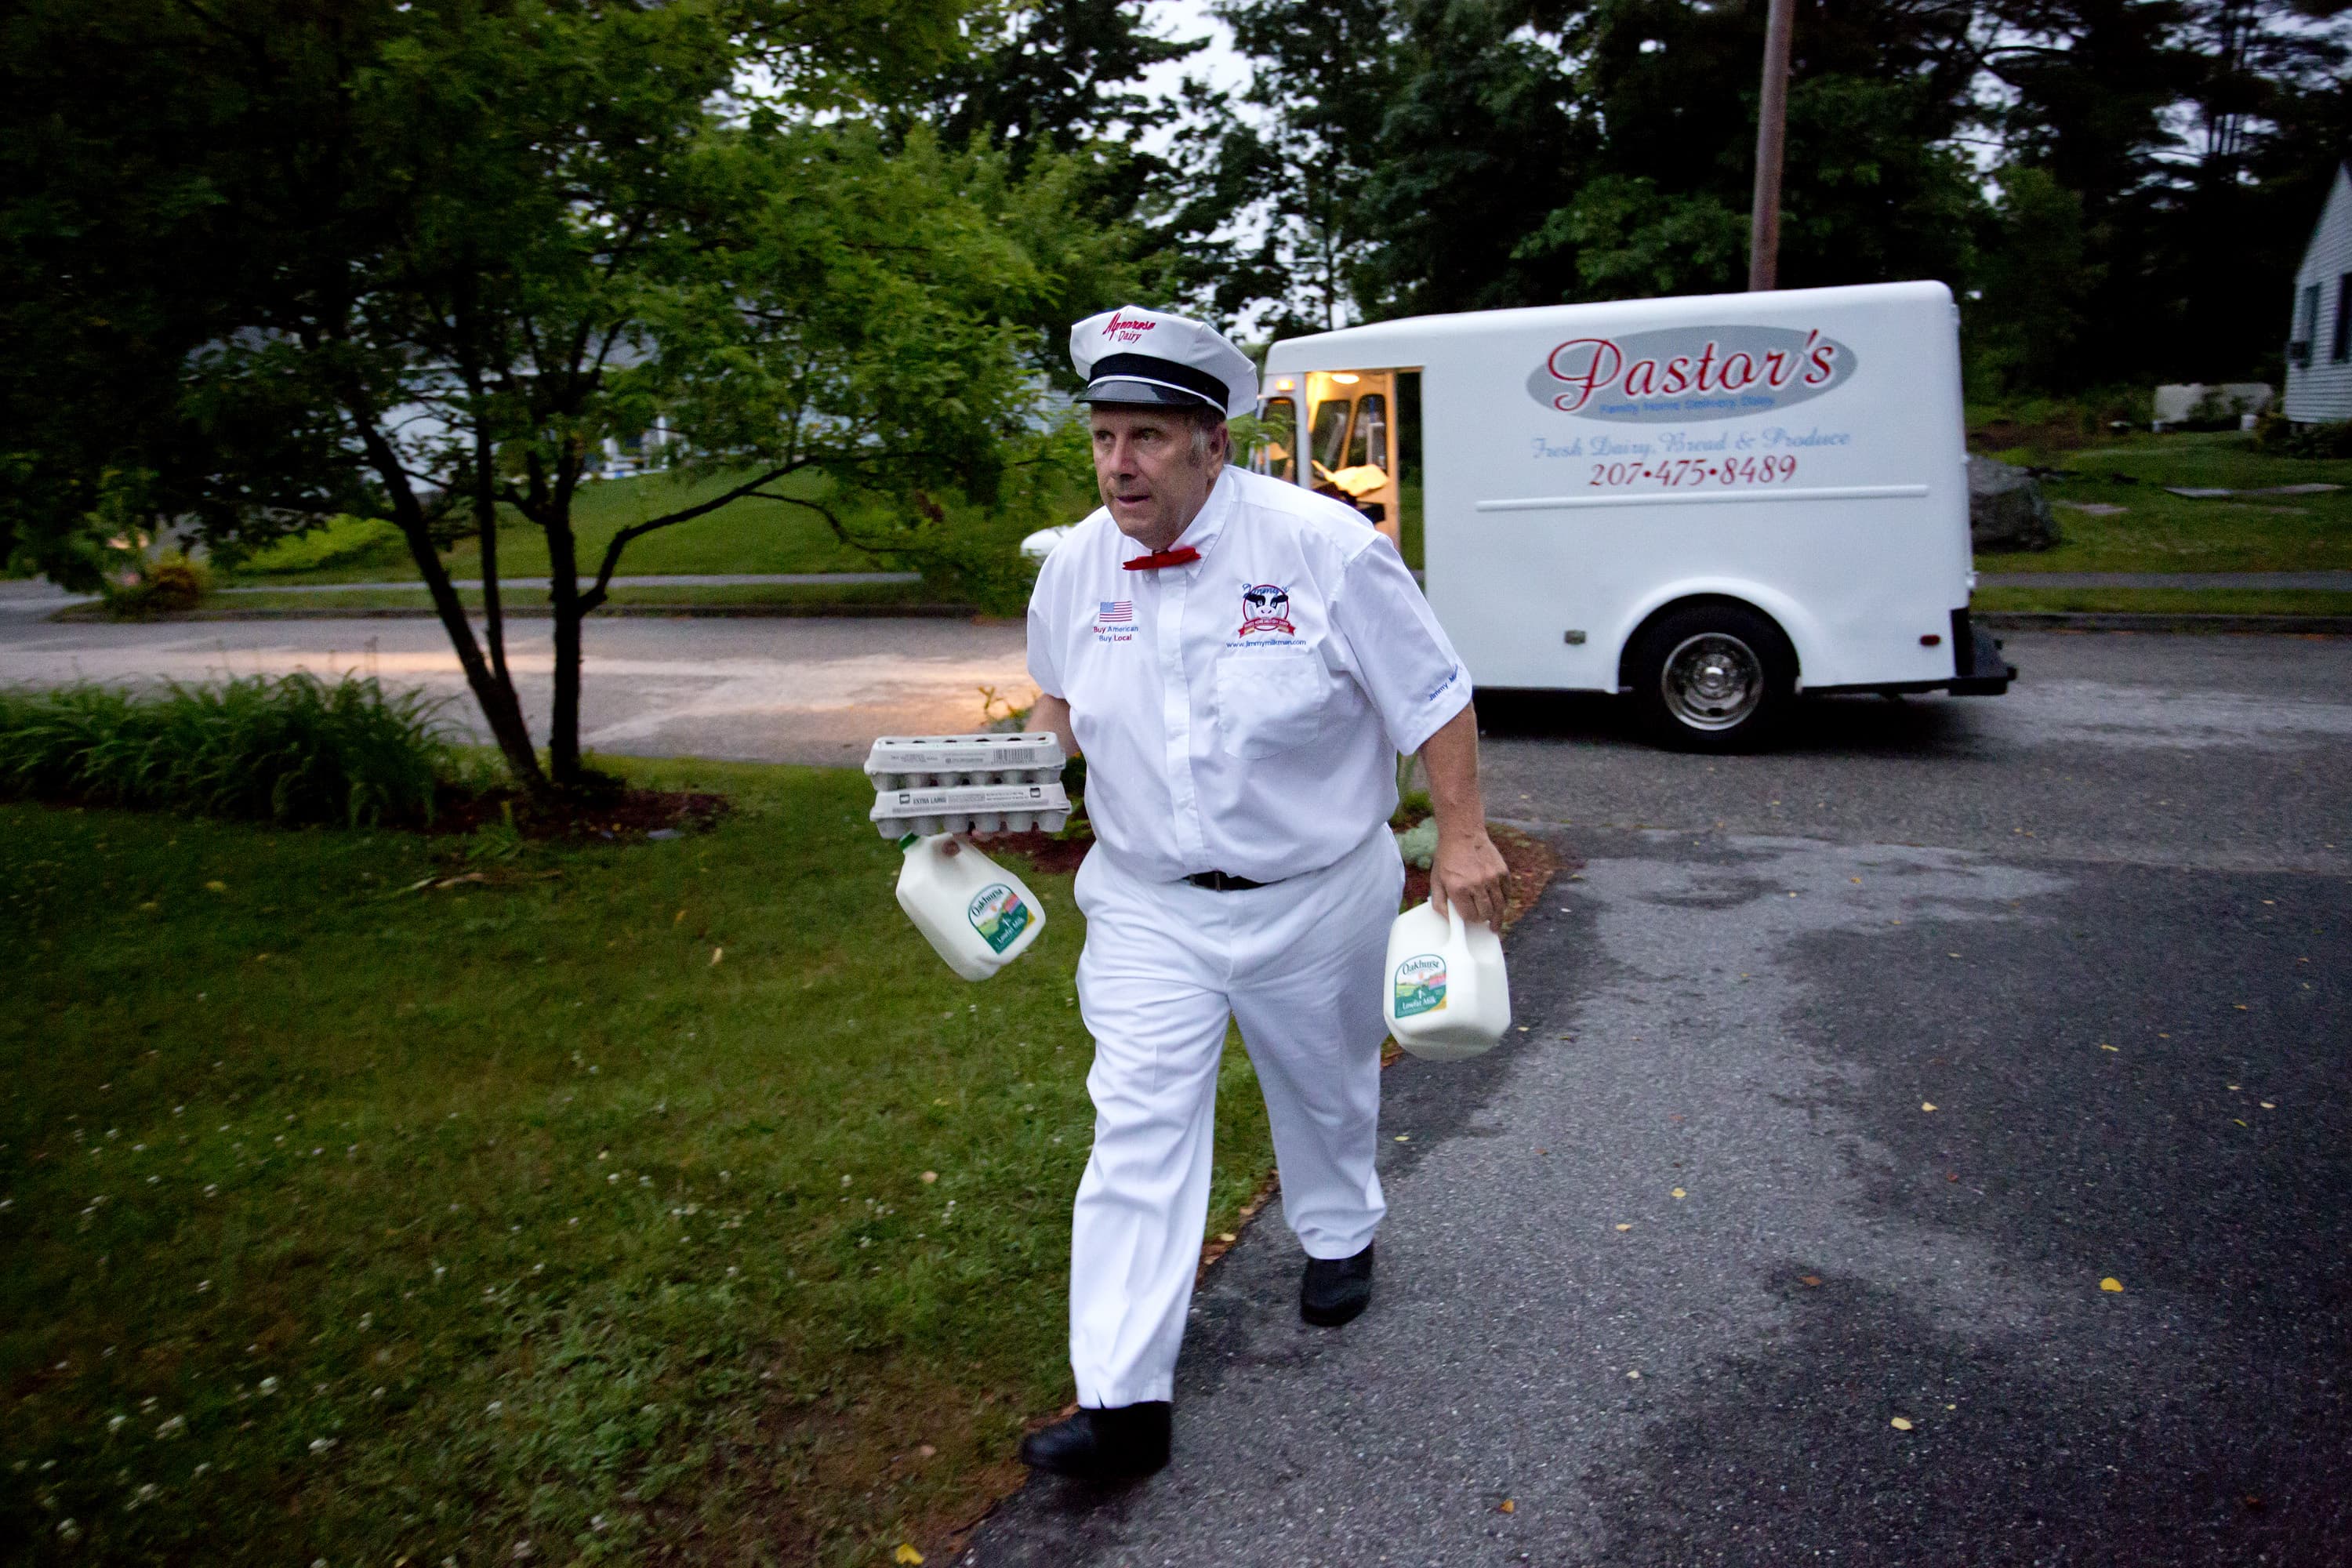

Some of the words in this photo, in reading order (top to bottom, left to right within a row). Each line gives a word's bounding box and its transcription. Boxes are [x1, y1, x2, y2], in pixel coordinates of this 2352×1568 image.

[1118, 330, 1142, 343] Dairy
[1547, 328, 1835, 412] Pastor's
[1531, 437, 1581, 459] Fresh
[1658, 431, 1727, 452] Bread
[1734, 432, 1755, 450] &
[1762, 426, 1850, 448] Produce
[1429, 682, 1449, 702] Jimmy
[972, 888, 1004, 917] Oakhurst
[1012, 916, 1025, 928] Milk
[1403, 959, 1439, 975] Oakhurst
[1402, 999, 1422, 1010] Lowfat
[1423, 995, 1436, 1004] Milk
